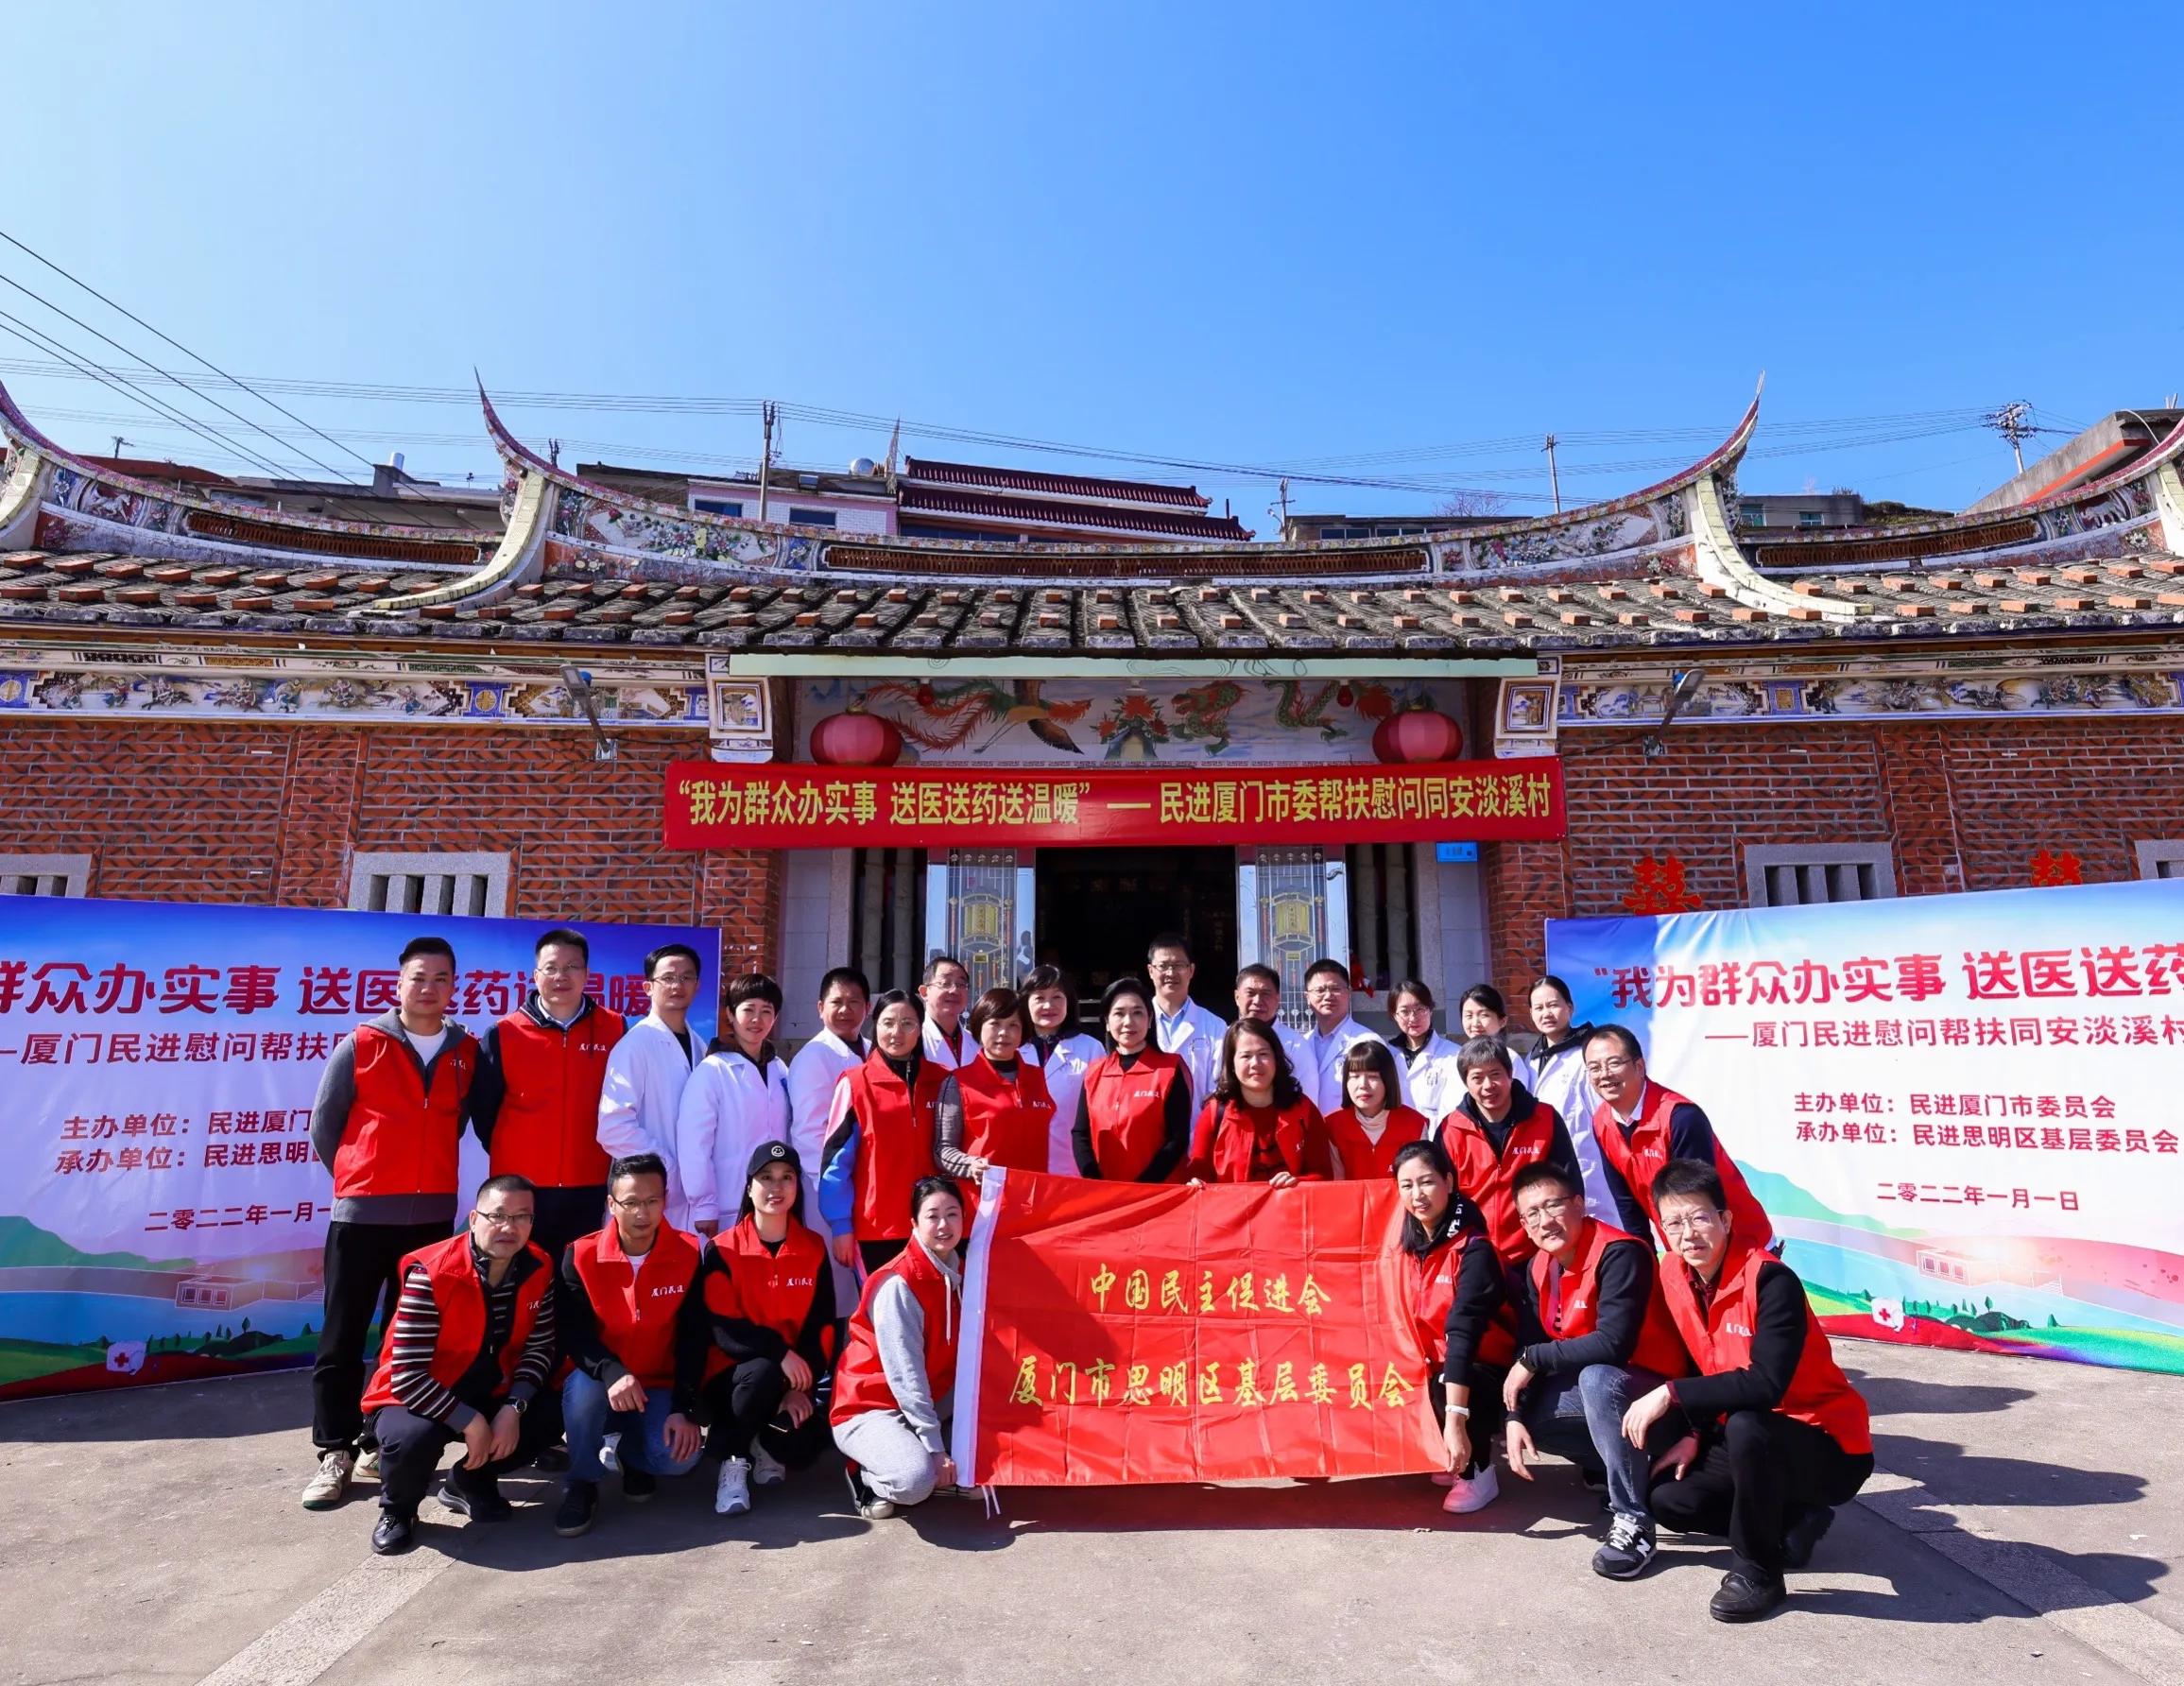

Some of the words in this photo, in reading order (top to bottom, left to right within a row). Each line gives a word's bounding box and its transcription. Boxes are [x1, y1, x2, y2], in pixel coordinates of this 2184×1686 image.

[679, 780, 877, 825] “我为群众办实事
[889, 781, 1091, 825] 送医送药送温暖”
[1910, 1093, 2116, 1119] 民进厦门市委员会
[1913, 1124, 2179, 1154] 民进思明区基层委员会
[204, 1141, 321, 1168] 民进思明
[1877, 1182, 2080, 1211] 二零二二年一月一日
[1090, 1263, 1332, 1315] 中国民主促进会
[1009, 1354, 1416, 1409] 厦门市思明区基层委员会
